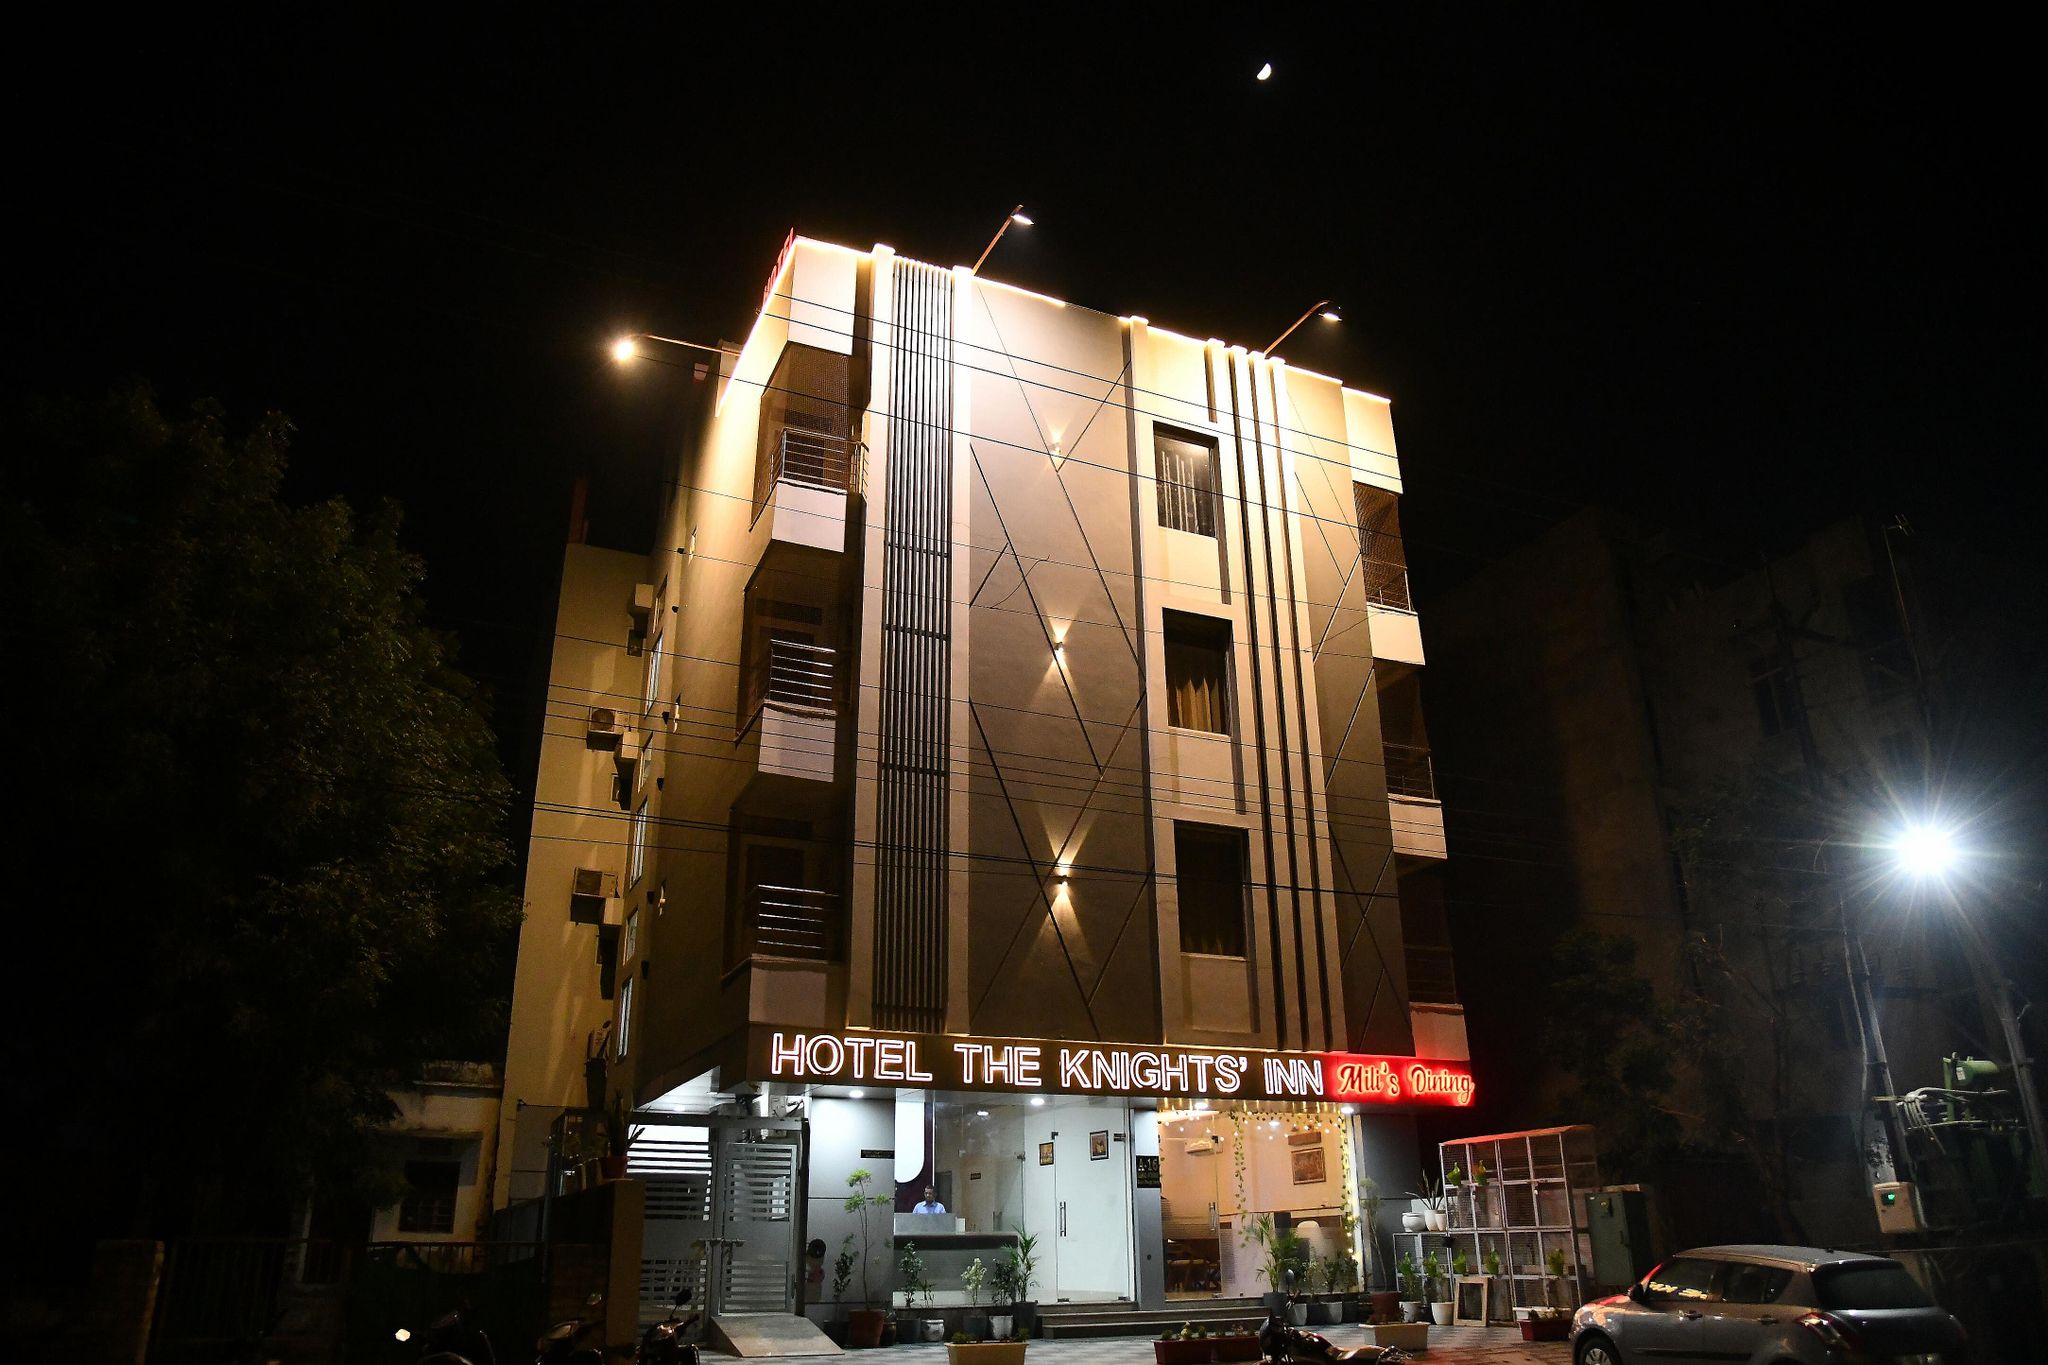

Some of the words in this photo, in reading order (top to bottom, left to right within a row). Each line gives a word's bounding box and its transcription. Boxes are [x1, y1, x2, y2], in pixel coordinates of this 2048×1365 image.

[771, 1033, 933, 1082] HOTEL
[954, 1043, 1042, 1087] THE
[1263, 1058, 1325, 1095] INN
[1408, 1064, 1475, 1105] Dining
